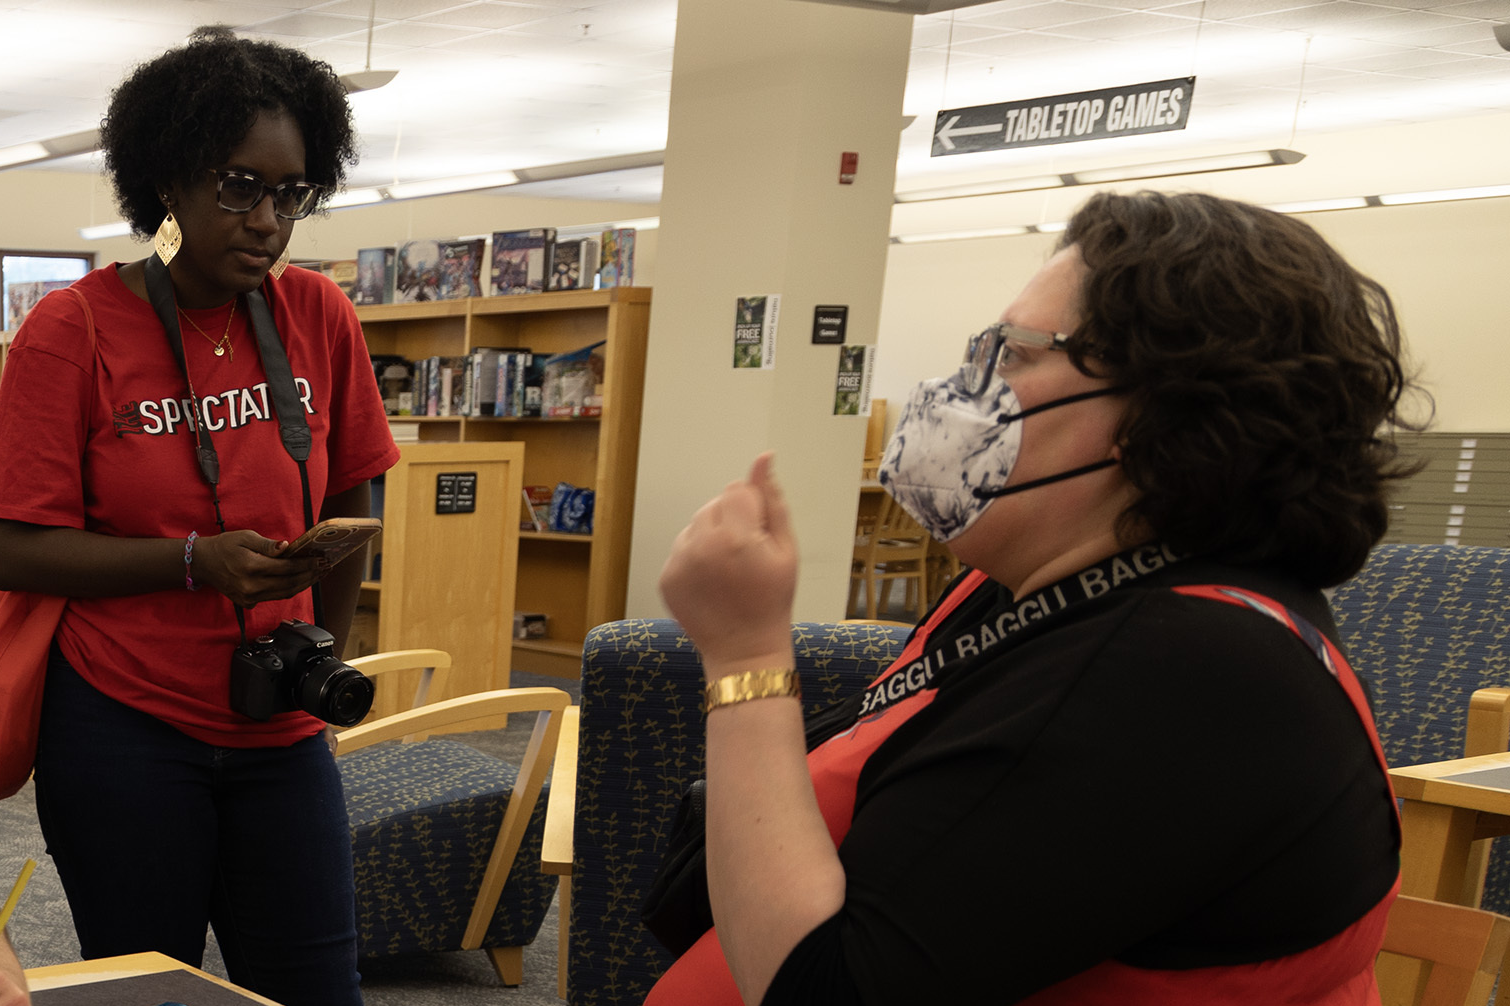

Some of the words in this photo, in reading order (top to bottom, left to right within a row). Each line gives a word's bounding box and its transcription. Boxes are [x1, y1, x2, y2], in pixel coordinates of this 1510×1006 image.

[1004, 99, 1104, 143] TABLETOP
[1106, 88, 1183, 132] GAMES
[737, 328, 761, 339] FREE
[838, 376, 861, 387] FREE
[139, 377, 315, 434] SPECTATR
[316, 640, 334, 648] Canon
